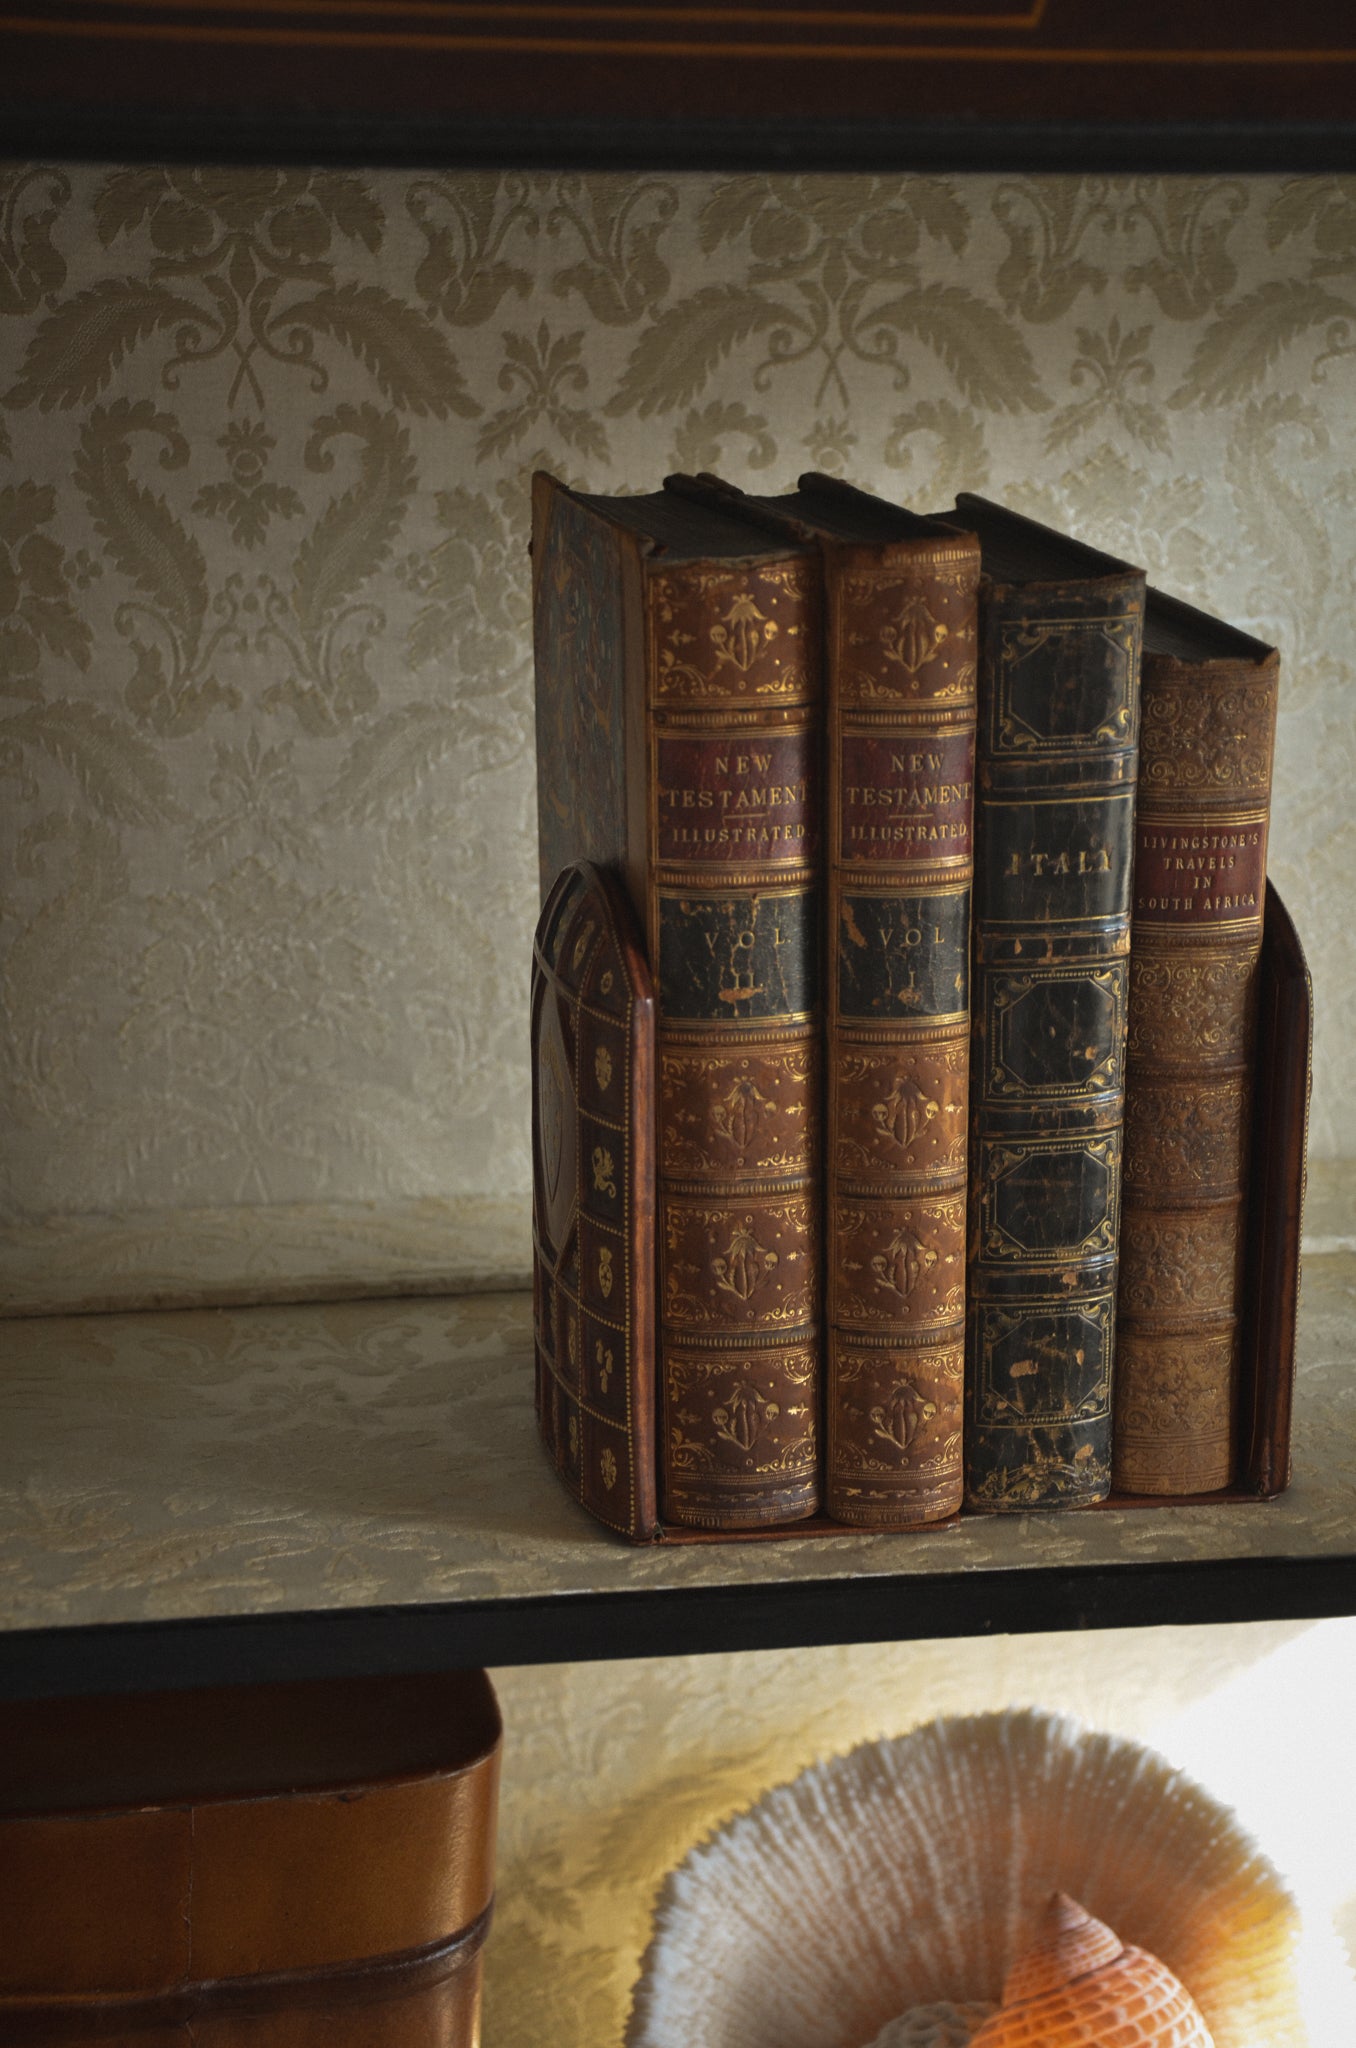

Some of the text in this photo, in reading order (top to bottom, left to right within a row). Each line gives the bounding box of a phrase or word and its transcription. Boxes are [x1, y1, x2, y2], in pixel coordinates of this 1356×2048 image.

[715, 755, 773, 775] NEW
[891, 754, 945, 773] NEW
[667, 784, 807, 808] TESTAMENT
[846, 782, 972, 806] TESTAMENT
[1143, 832, 1260, 850] LIVINGSTONE'S
[1004, 848, 1112, 877] ITALY
[1163, 856, 1236, 870] TRAVELS
[1193, 876, 1212, 889] IN
[1138, 898, 1193, 911] SOUTH
